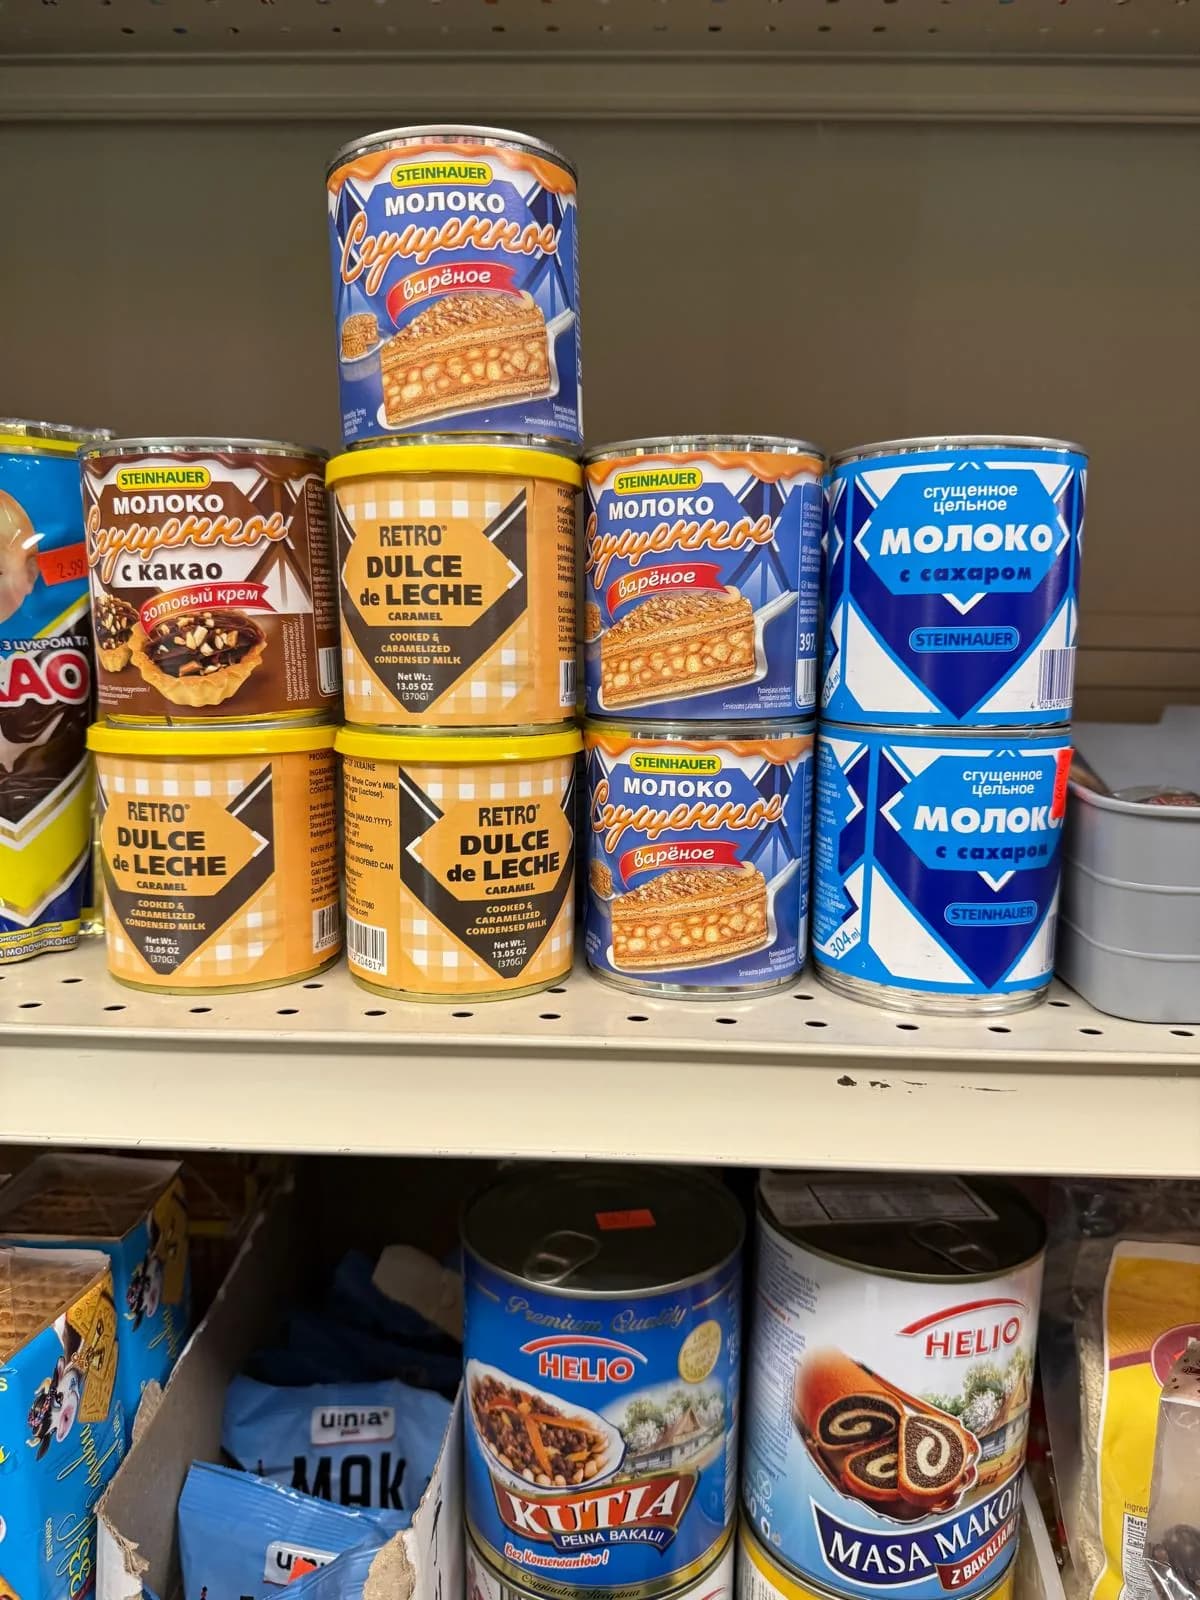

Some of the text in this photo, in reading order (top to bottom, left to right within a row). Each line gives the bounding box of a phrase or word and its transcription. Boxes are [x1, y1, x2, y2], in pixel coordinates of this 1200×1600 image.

[396, 166, 487, 182] STEINHAUER
[385, 191, 505, 217] МОЛОКО
[341, 210, 558, 296] Сгущенное
[402, 268, 492, 299] варёное
[121, 471, 205, 486] STEINHAUER
[617, 472, 697, 489] STEINHAUER
[923, 484, 1018, 502] сгущенное
[113, 494, 224, 515] МОЛОКО
[609, 496, 714, 520] МОЛОКО
[933, 499, 1007, 515] цельное
[880, 524, 1053, 556] МОЛОКО
[57, 559, 84, 578] 2.99
[139, 560, 223, 581] какао
[367, 555, 462, 578] DULCE
[618, 571, 696, 597] варёное
[900, 567, 1032, 585] с сахаром
[359, 584, 482, 606] de LECHE
[143, 588, 258, 621] готовый крем
[388, 612, 443, 621] CARAMEL
[14, 636, 73, 651] ЦУКРОМ
[389, 632, 429, 642] COOKED
[915, 633, 1014, 648] STEINHAUER
[381, 644, 451, 653] CARAMELIZED
[374, 656, 461, 665] CONDENSED MILK
[0, 651, 90, 702] АО
[397, 672, 415, 681] Net
[396, 682, 434, 691] 13.05 OZ
[635, 757, 716, 770] STEINHAUER
[365, 779, 381, 788] Cow's
[962, 769, 1043, 783] сгущенное
[623, 777, 732, 798] МОЛОКО
[972, 783, 1035, 798] цельное
[118, 827, 206, 851] DULCE
[460, 829, 549, 856] DULCE
[634, 847, 714, 868] варёное
[957, 844, 1048, 863] сахаром
[113, 855, 227, 877] de LECHE
[380, 862, 393, 871] CAN
[447, 852, 560, 882] de LECHE
[136, 881, 187, 891] CARAMEL
[485, 883, 535, 895] CARAMEL
[138, 900, 175, 909] COOKED
[486, 903, 525, 914] COOKED
[131, 909, 196, 920] CARAMELIZED
[475, 911, 541, 924] CARAMELIZED
[950, 906, 1034, 921] STEINHAUER
[125, 919, 206, 931] CONDENSED MILK
[466, 919, 547, 936] CONDENSED MILK
[145, 936, 159, 945] Net
[494, 940, 509, 949] Net
[830, 927, 861, 958] 304 ml
[144, 945, 166, 954] 13.05
[492, 948, 527, 958] 13.05 OZ
[505, 1296, 602, 1332] Premium
[925, 1316, 1021, 1358] HELIO
[539, 1352, 635, 1383] HELIO
[505, 1480, 680, 1534] KUTIA
[610, 1529, 665, 1543] BAKALII
[505, 1543, 522, 1562] Bez
[829, 1531, 932, 1576] MASA
[950, 1569, 961, 1585] Z
